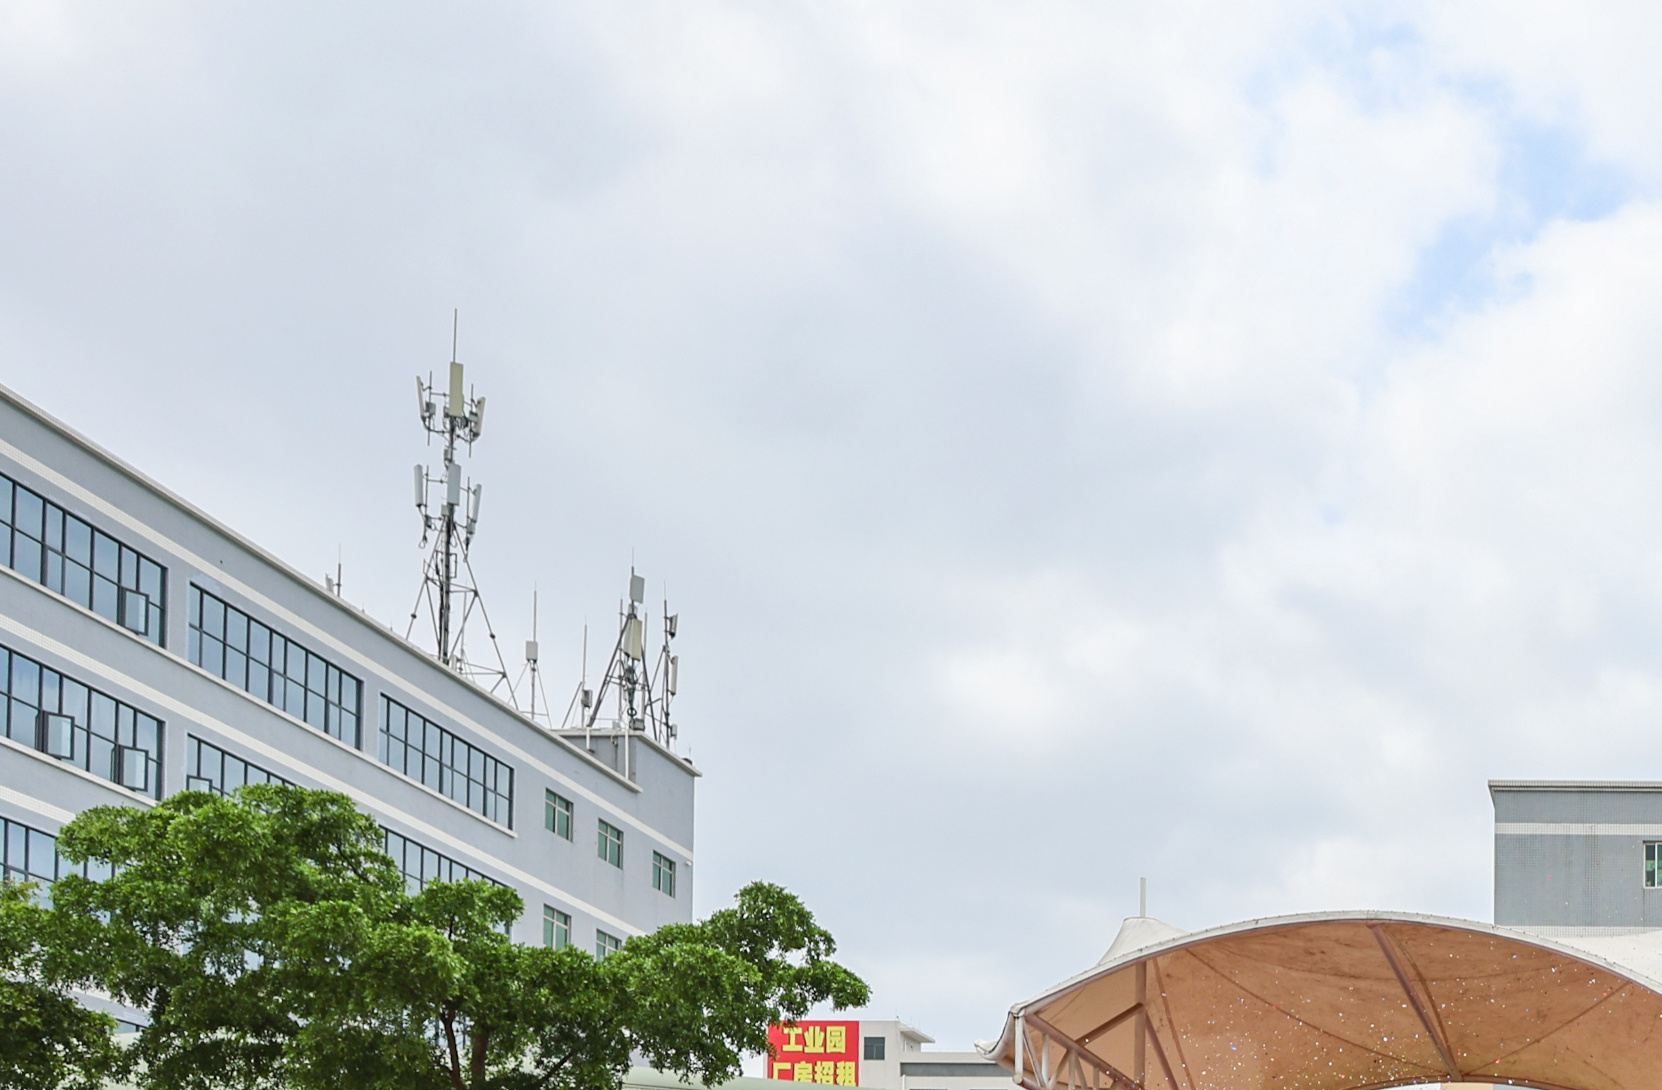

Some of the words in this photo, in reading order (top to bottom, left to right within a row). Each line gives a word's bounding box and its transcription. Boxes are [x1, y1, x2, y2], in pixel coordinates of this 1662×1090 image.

[782, 1026, 846, 1053] 工业园
[772, 1060, 856, 1086] 厂房招租
